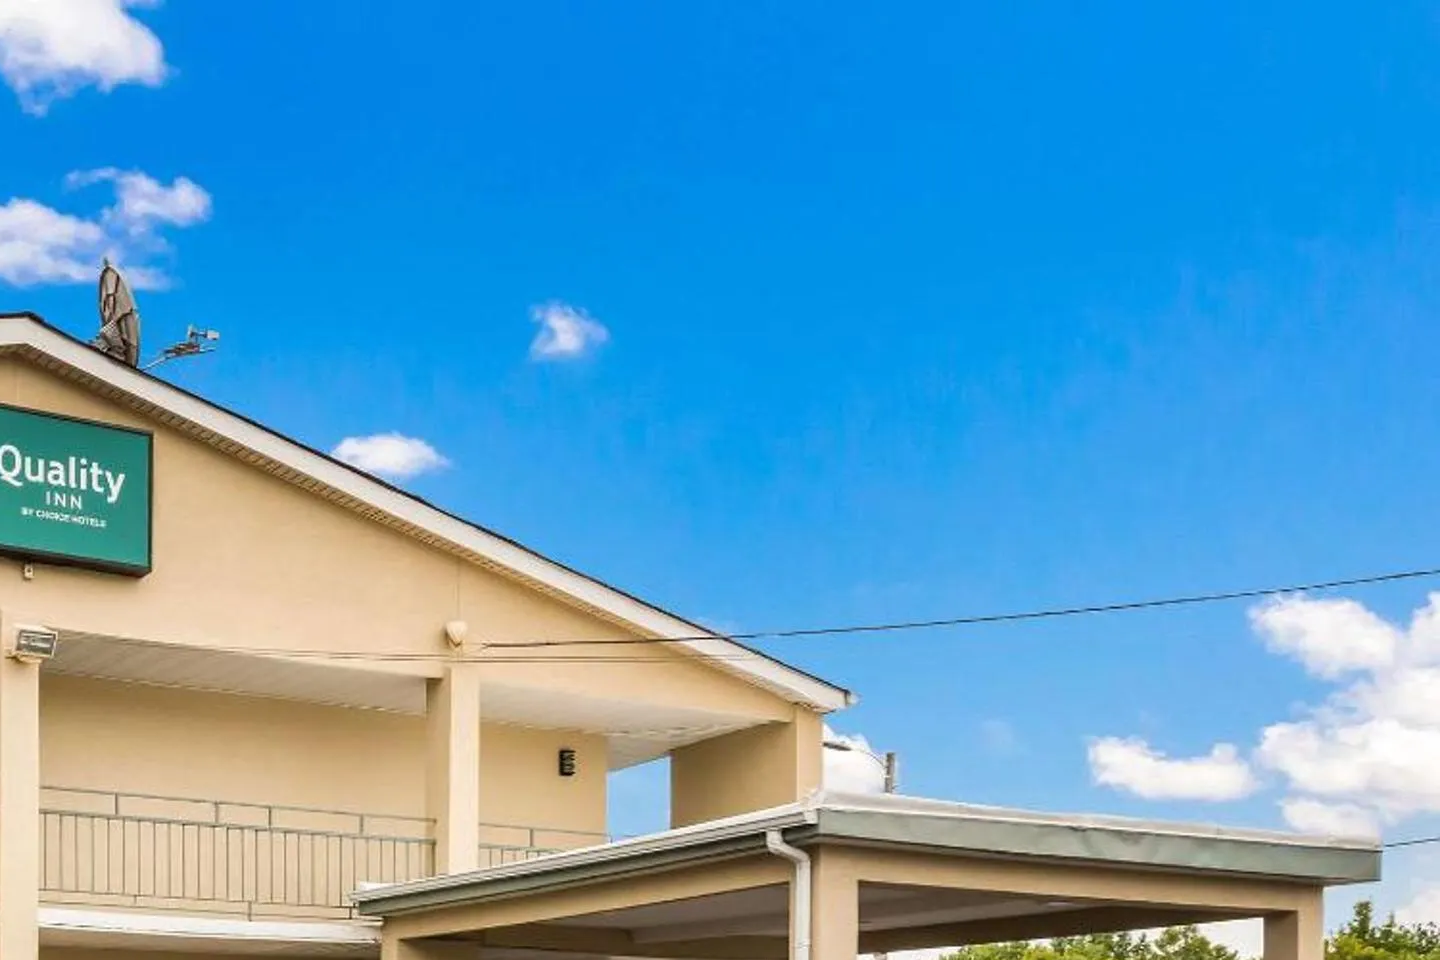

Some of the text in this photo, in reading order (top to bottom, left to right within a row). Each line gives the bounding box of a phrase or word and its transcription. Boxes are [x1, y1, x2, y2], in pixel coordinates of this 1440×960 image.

[46, 491, 82, 510] INN
[21, 507, 107, 528] BY CHOICE HOTELS
